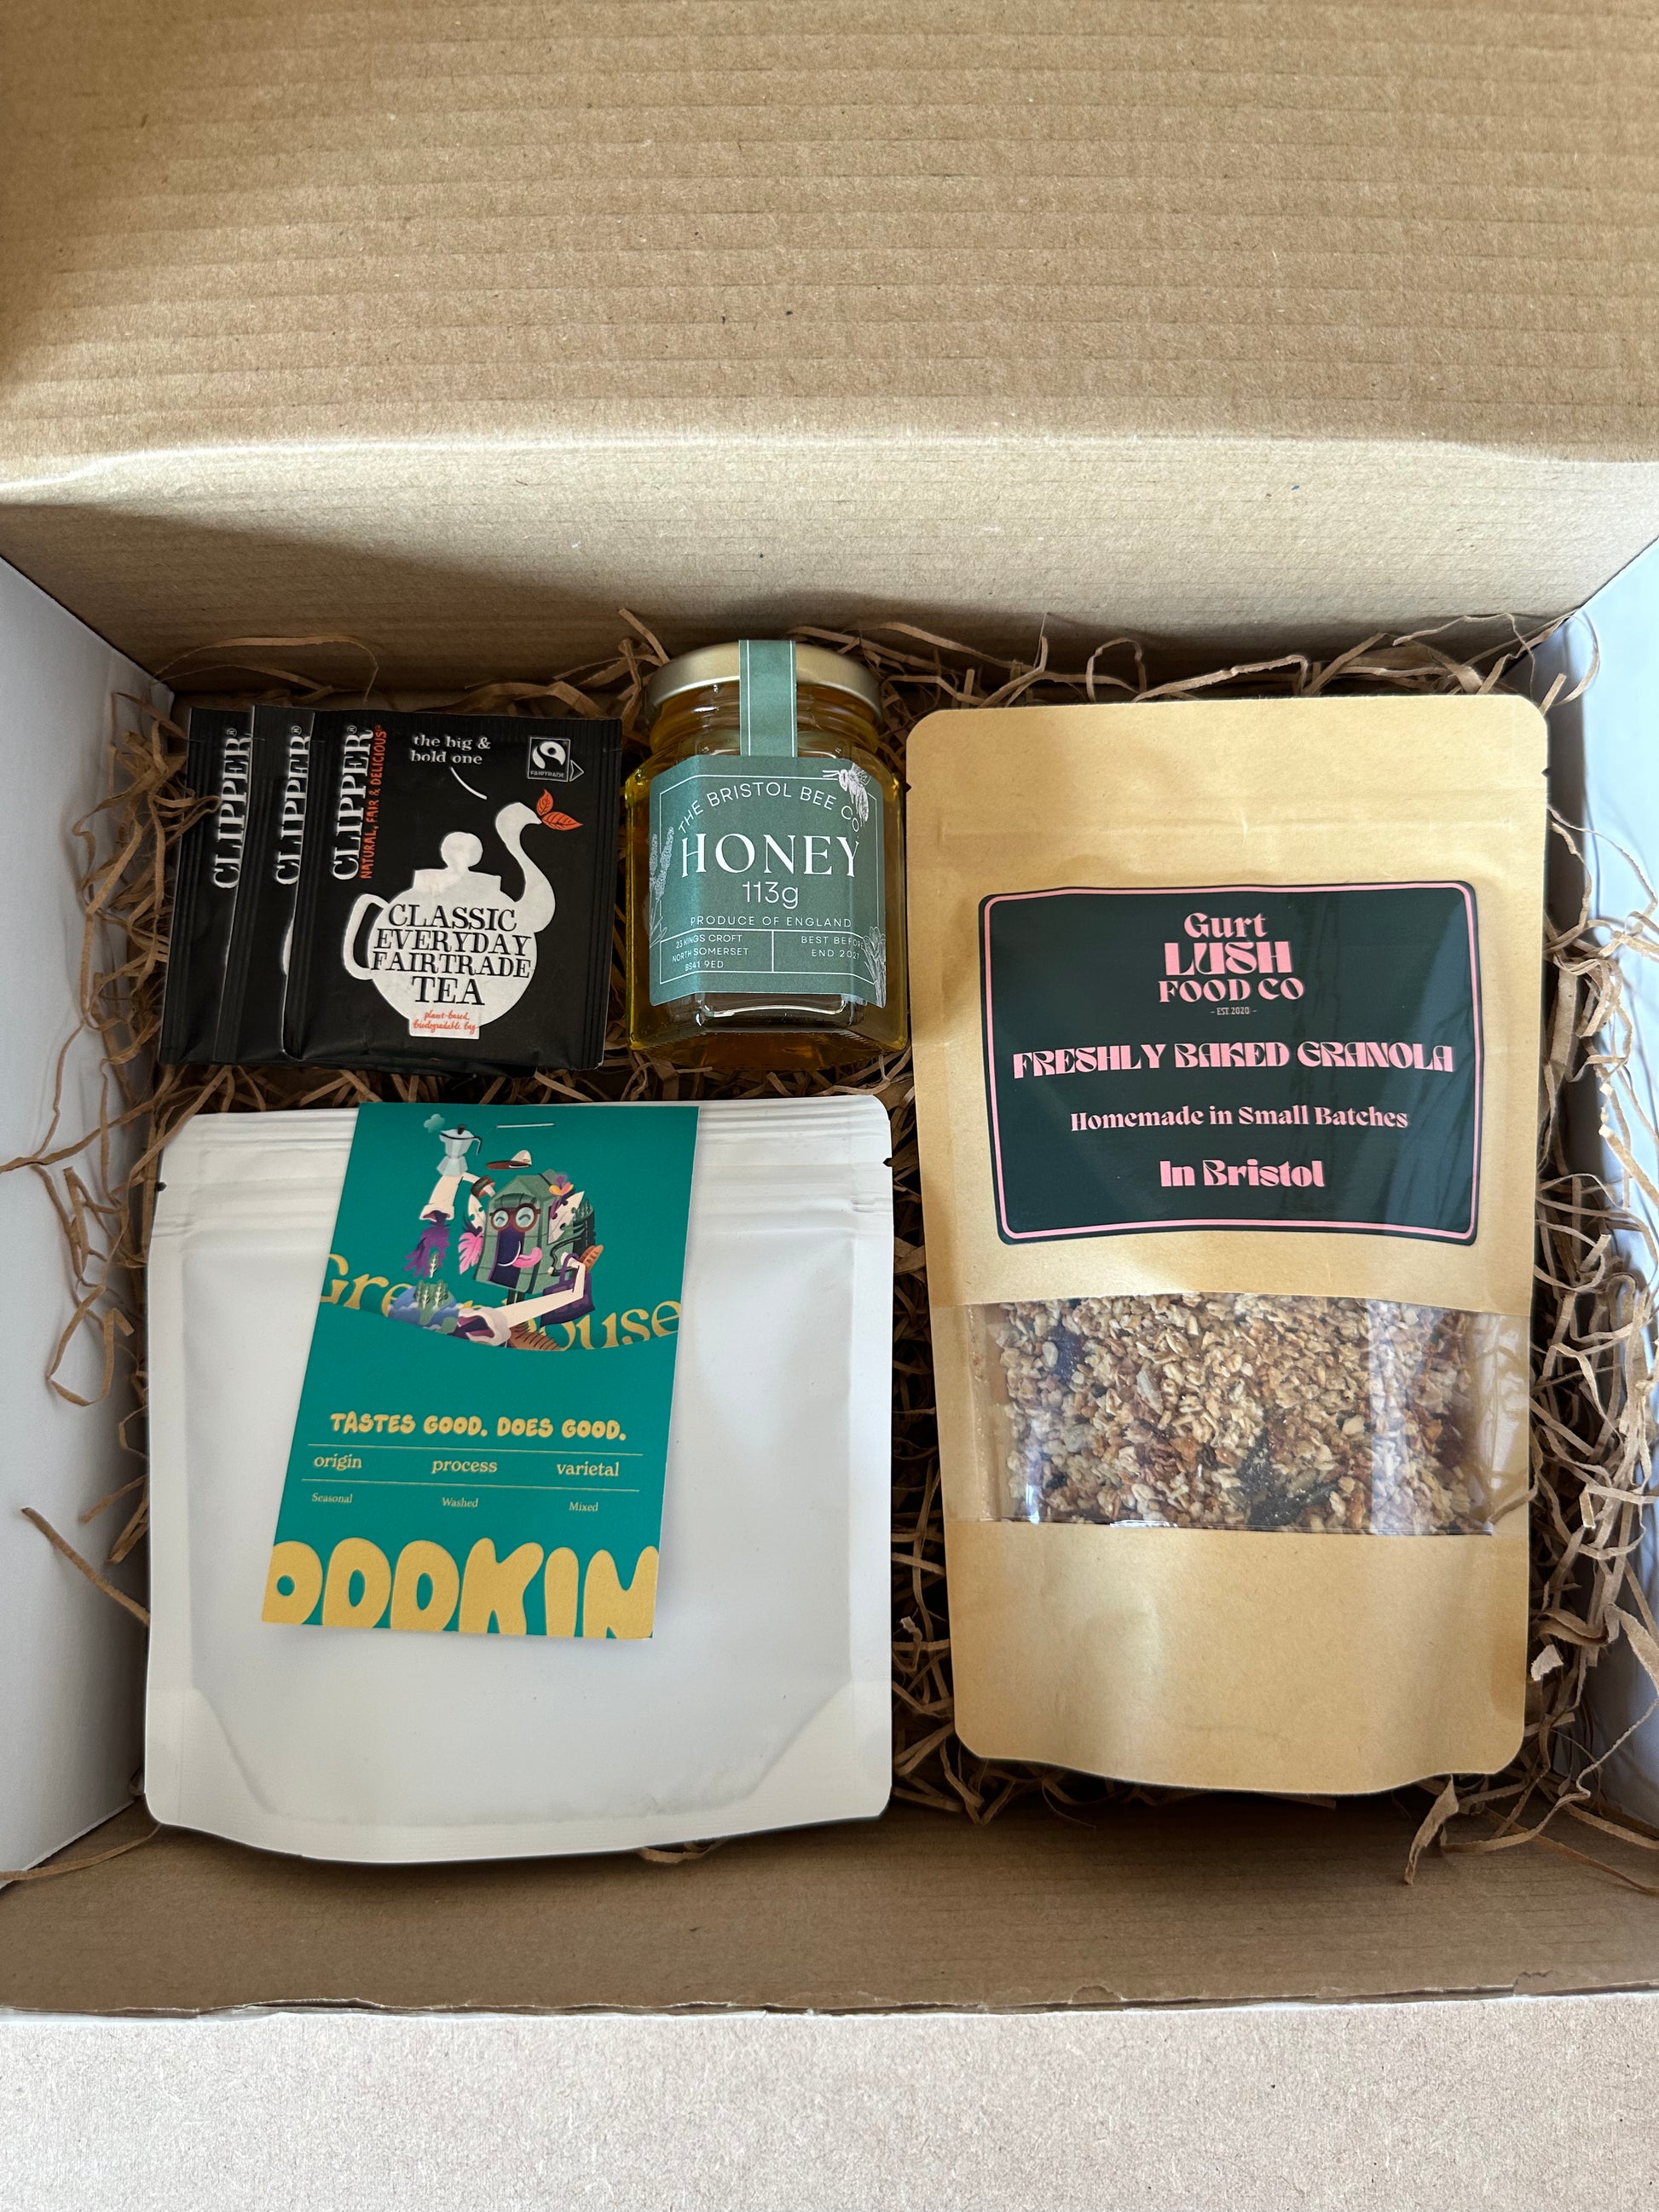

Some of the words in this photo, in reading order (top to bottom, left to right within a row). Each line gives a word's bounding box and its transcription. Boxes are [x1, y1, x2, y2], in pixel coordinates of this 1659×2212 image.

[413, 735, 441, 747] the
[446, 736, 473, 750] big
[477, 736, 491, 749] &
[410, 750, 447, 763] bold
[452, 754, 483, 765] one
[529, 770, 566, 778] FAIRTRADE
[368, 788, 381, 796] &
[366, 800, 379, 823] FAIR
[678, 800, 703, 834] THE
[707, 782, 792, 807] BRISTOL
[800, 786, 837, 811] BEE
[681, 833, 859, 878] HONEY
[742, 881, 799, 910] 113g
[389, 904, 517, 932] CLASSIC
[691, 915, 755, 927] PRODUCE
[762, 916, 779, 926] OF
[786, 916, 852, 927] ENGLAND
[1183, 912, 1269, 939] Gurt
[373, 928, 532, 956] EVERYDAY
[672, 950, 692, 962] NORTH
[693, 947, 749, 956] SOMERSET
[675, 939, 683, 950] 23
[683, 934, 706, 946] KINGS
[708, 934, 743, 943] CROFT
[801, 936, 829, 944] BEST
[834, 937, 864, 950] BEFORE
[812, 949, 835, 957] END
[370, 950, 532, 978] FAIRTRADE
[685, 961, 701, 972] BS41
[704, 960, 724, 968] 9ED
[1164, 940, 1293, 976] LUSH
[412, 976, 485, 1006] TEA
[1158, 979, 1251, 1003] FOOD
[1257, 977, 1304, 1001] CO
[413, 1019, 460, 1033] biodegradable
[464, 1021, 476, 1035] bag
[1013, 1043, 1166, 1079] FRESHLY
[1173, 1041, 1291, 1069] BAKED
[1297, 1041, 1454, 1074] GRANOLA
[1070, 1106, 1205, 1132] Homemade
[1209, 1106, 1234, 1125] in
[1238, 1105, 1309, 1125] Small
[1314, 1106, 1409, 1129] Batches
[1159, 1160, 1196, 1187] In
[1202, 1158, 1326, 1187] Bristol
[329, 1410, 416, 1435] TASTES
[423, 1414, 488, 1438] GOOD.
[497, 1417, 554, 1438] DOES
[561, 1418, 627, 1441] GOOD.
[313, 1453, 362, 1472] origin
[431, 1458, 499, 1476] process
[556, 1461, 620, 1478] varietal
[311, 1492, 353, 1504] Seasonal
[442, 1496, 479, 1508] Washed
[569, 1500, 599, 1512] Mixed
